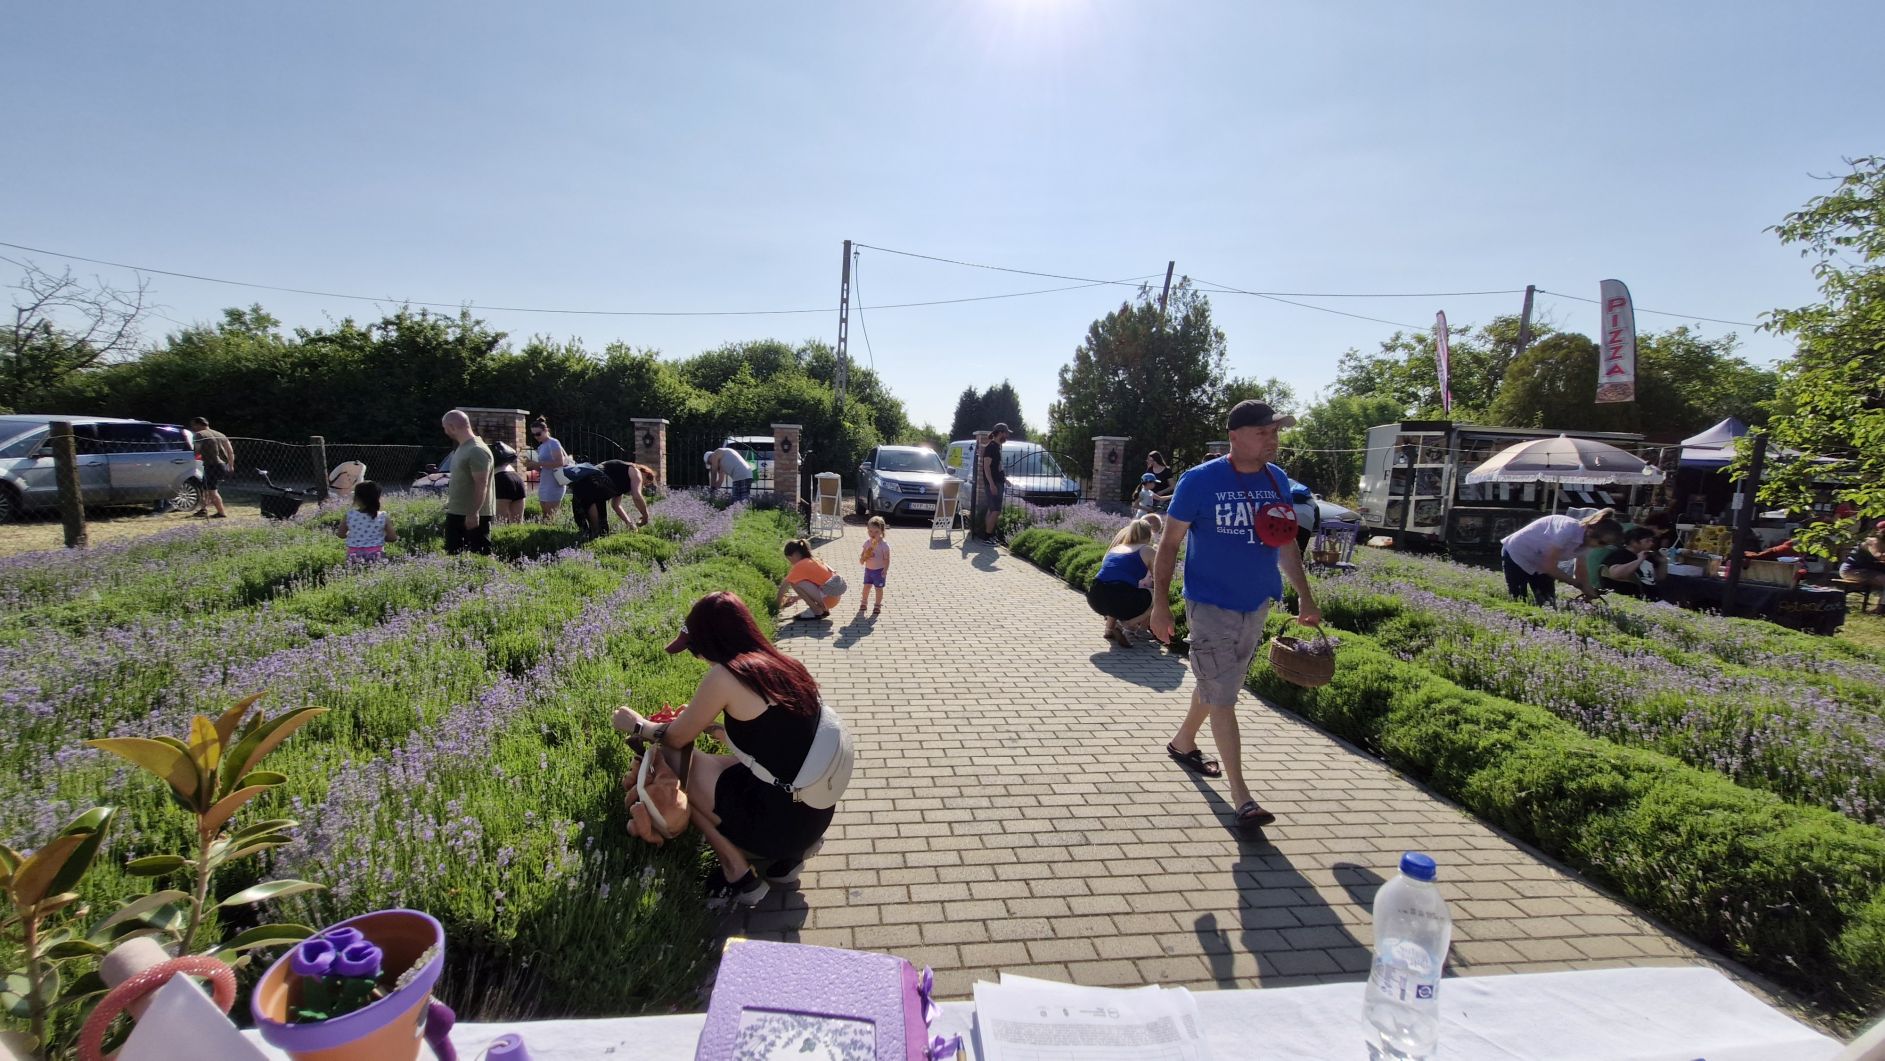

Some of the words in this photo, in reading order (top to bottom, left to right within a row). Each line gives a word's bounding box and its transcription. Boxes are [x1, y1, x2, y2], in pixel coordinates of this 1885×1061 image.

[1605, 297, 1627, 376] PIZZA
[1215, 502, 1271, 527] HAV
[1216, 526, 1246, 535] Since
